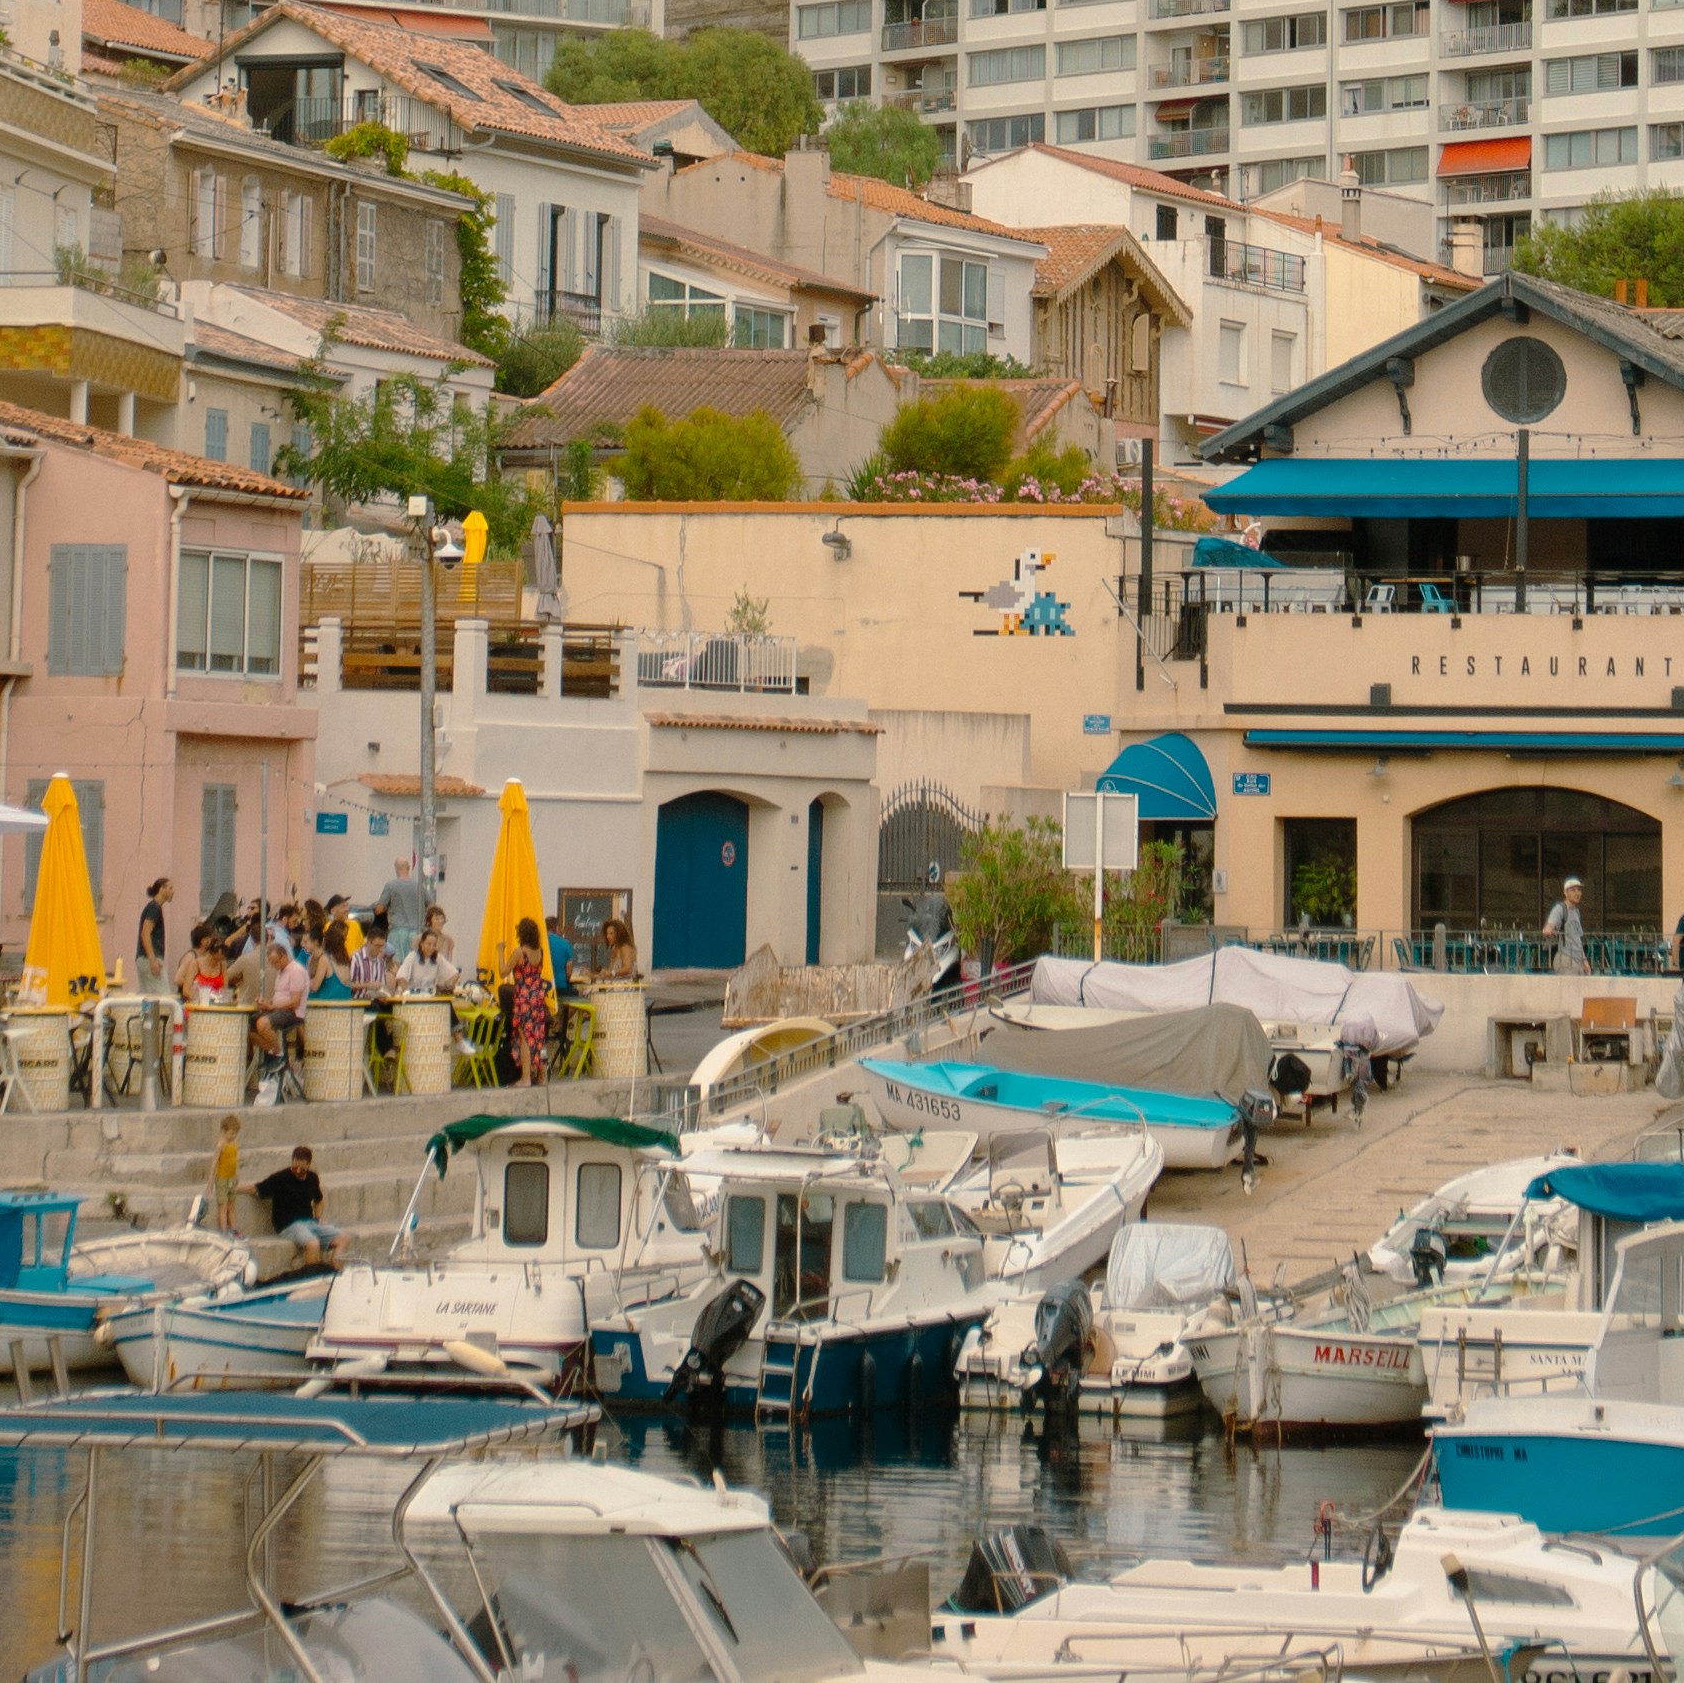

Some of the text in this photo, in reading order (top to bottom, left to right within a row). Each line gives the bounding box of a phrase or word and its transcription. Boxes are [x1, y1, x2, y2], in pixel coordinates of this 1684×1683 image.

[1411, 654, 1674, 678] RESTAURANT
[885, 1081, 962, 1122] MA 431653
[435, 1301, 450, 1314] LA
[1314, 1344, 1412, 1370] MARSEILL
[1529, 1353, 1583, 1366] SANTA M
